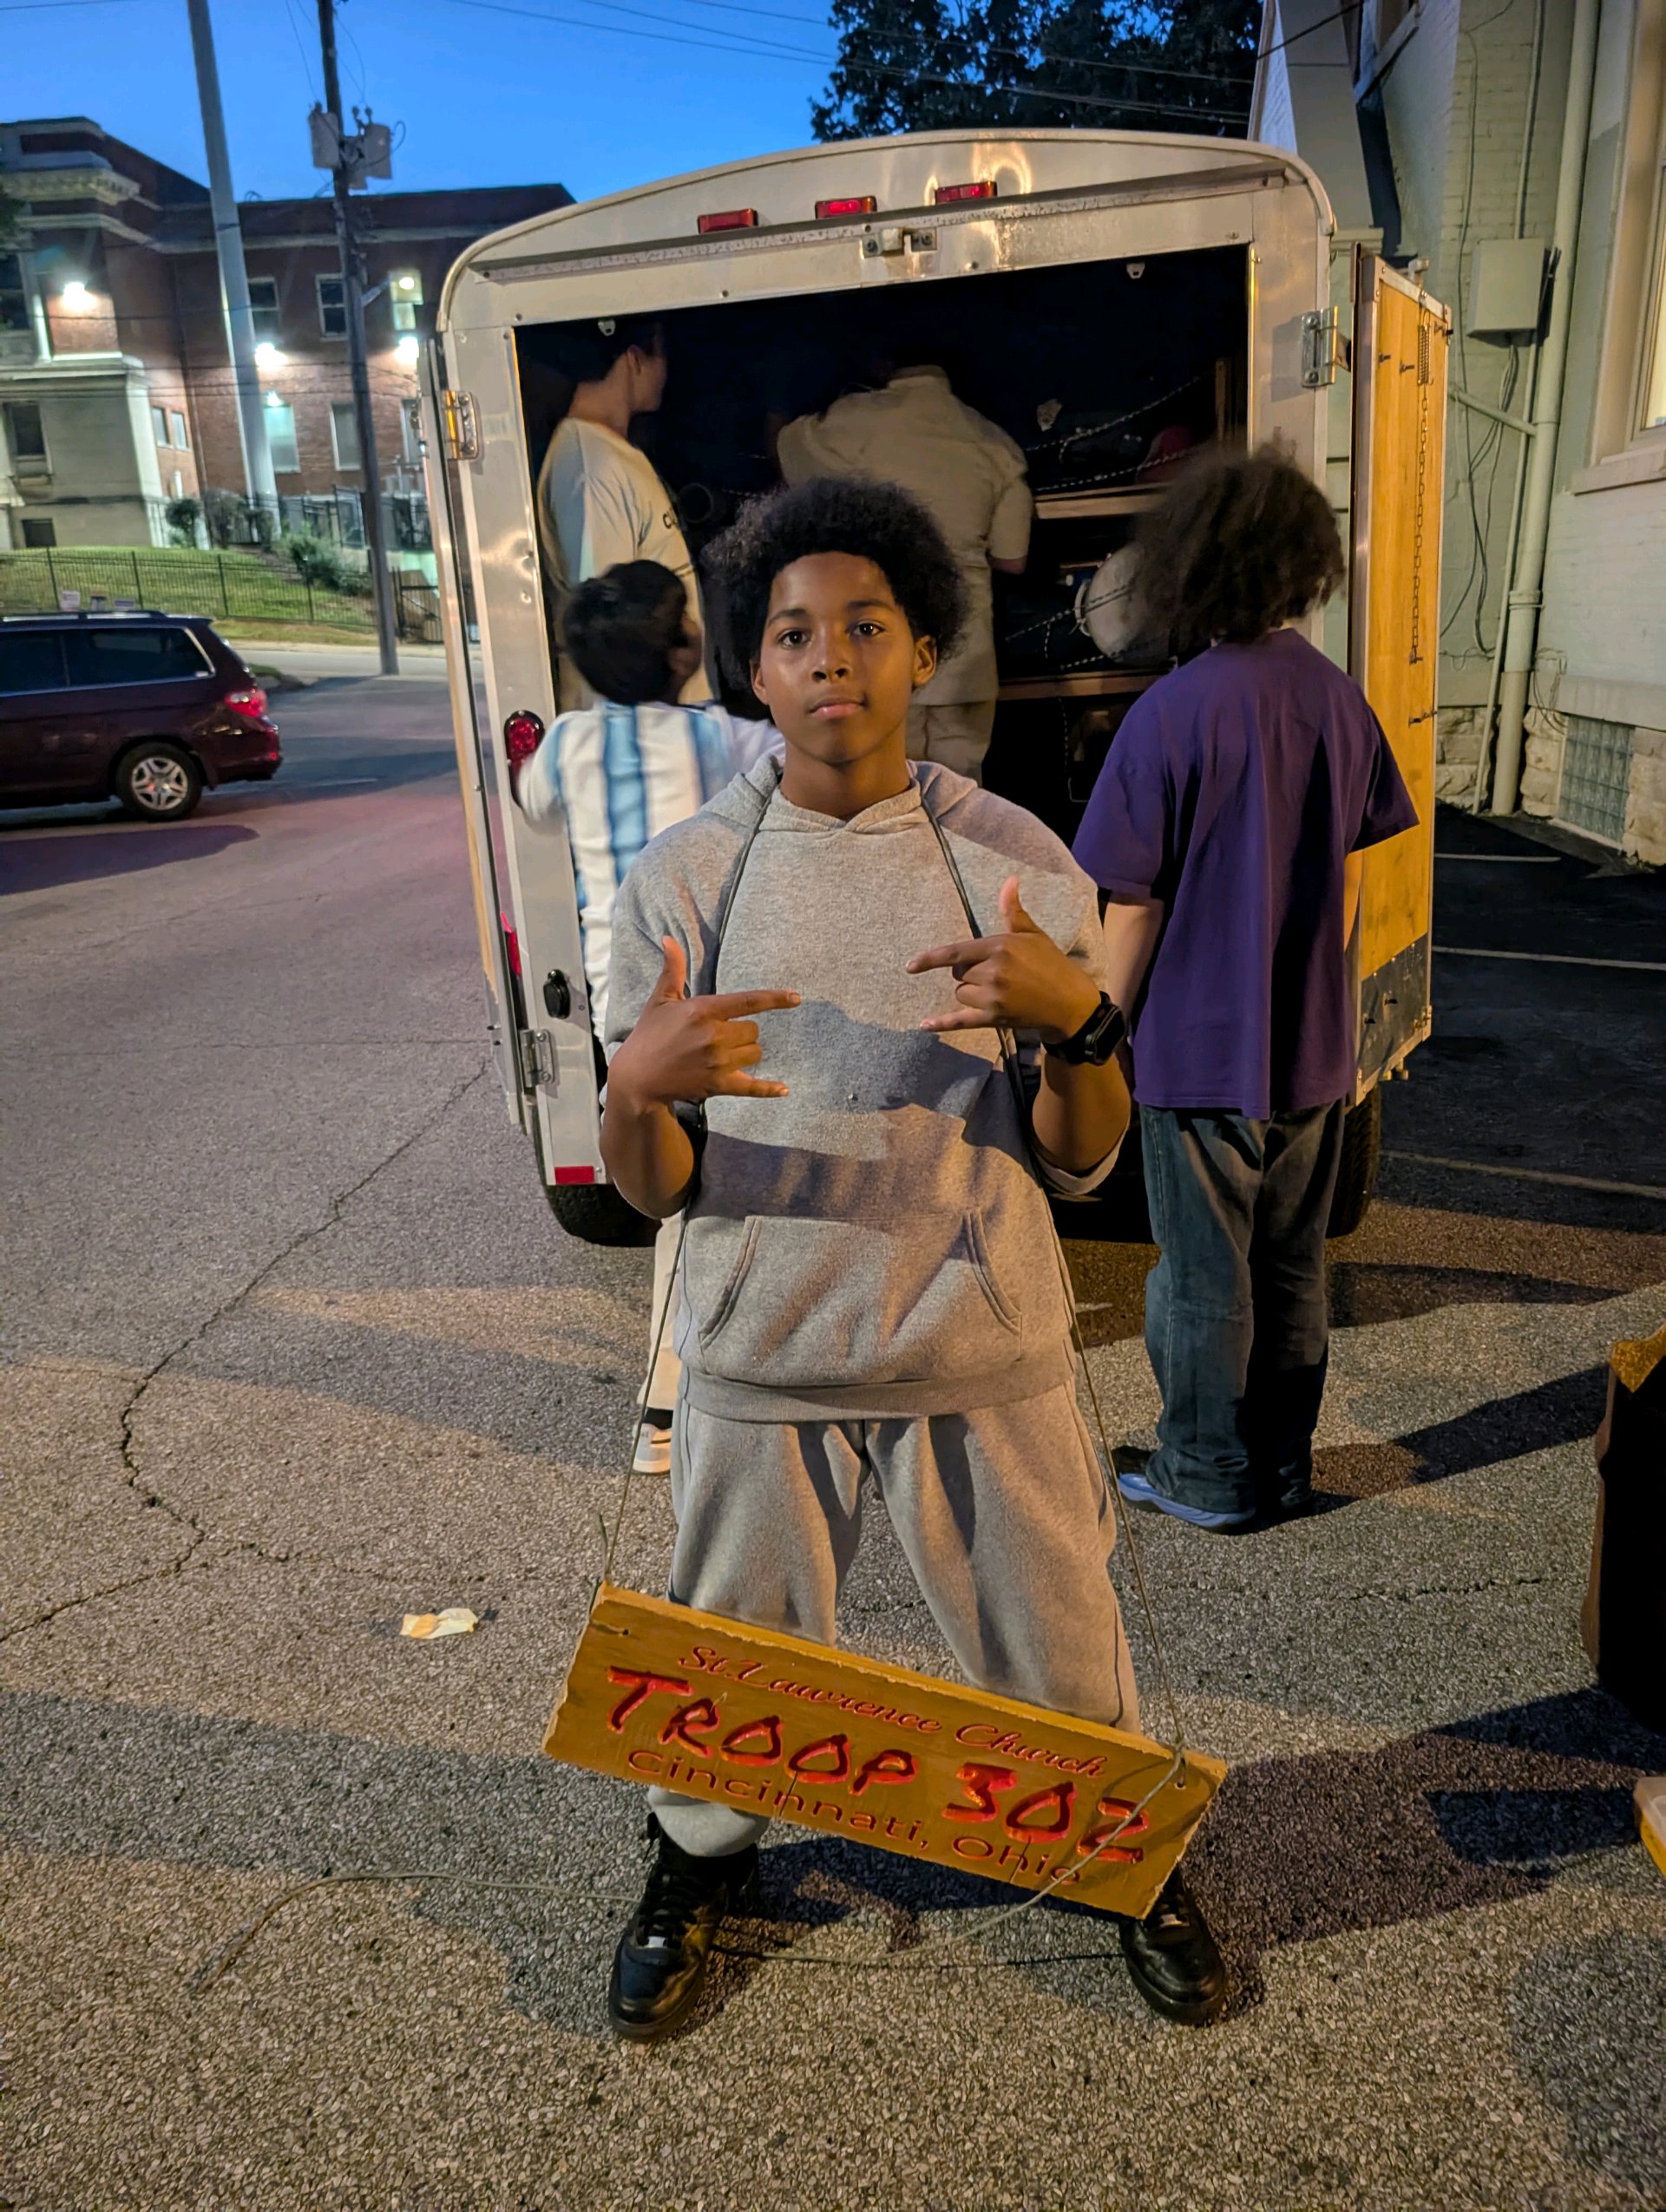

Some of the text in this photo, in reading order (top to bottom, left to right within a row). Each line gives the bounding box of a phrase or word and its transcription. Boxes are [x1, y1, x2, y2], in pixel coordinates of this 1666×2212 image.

[606, 1666, 1150, 1863] TROOP 302
[736, 1659, 942, 1733] Lawrence
[955, 1723, 1108, 1778] Church
[627, 1750, 1081, 1885] Cincinnati, Ohio
